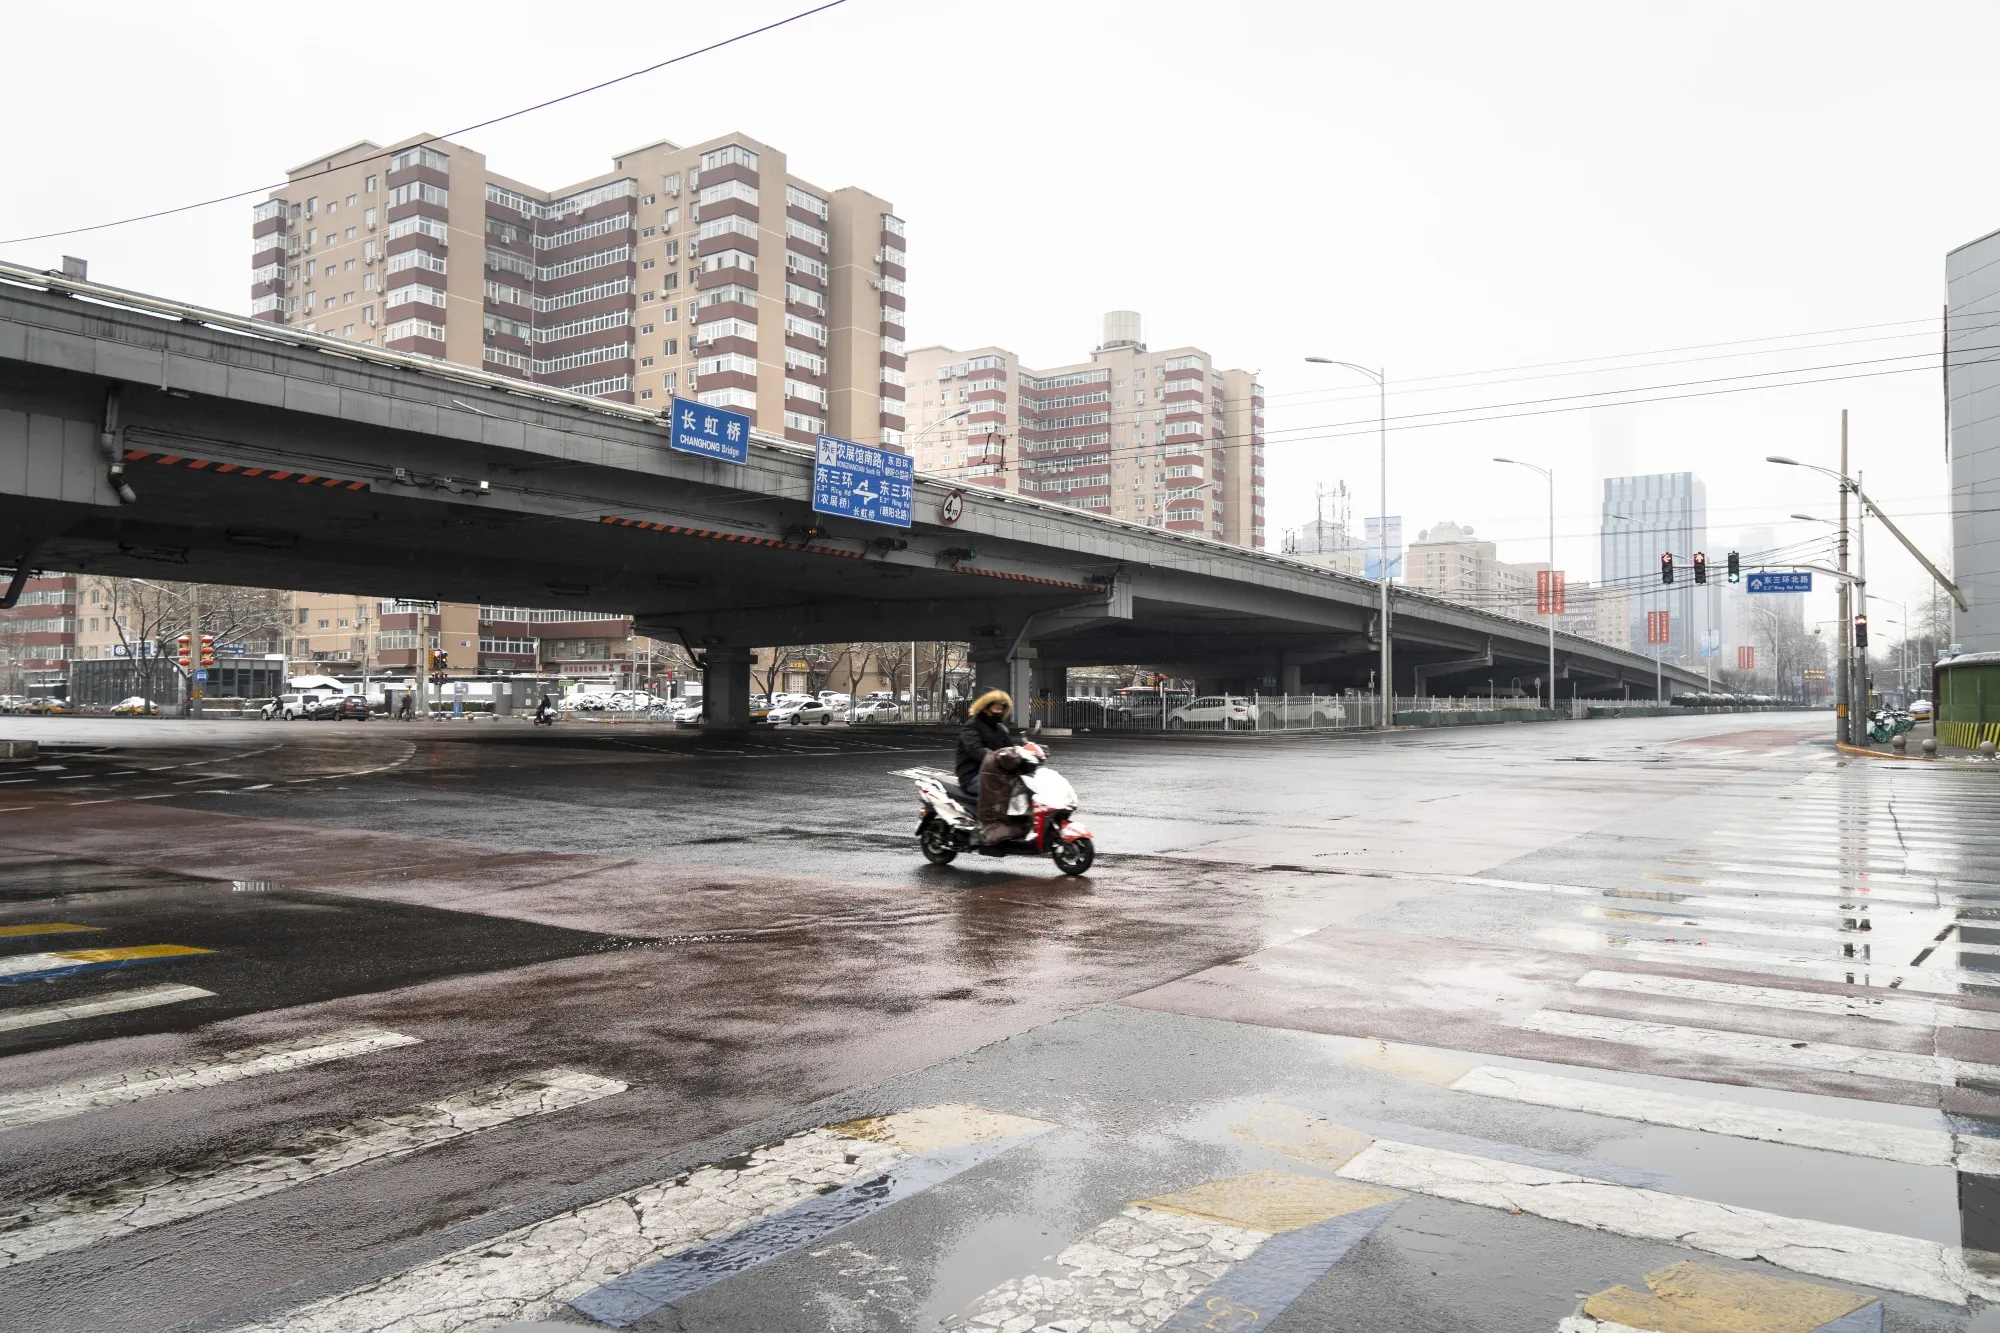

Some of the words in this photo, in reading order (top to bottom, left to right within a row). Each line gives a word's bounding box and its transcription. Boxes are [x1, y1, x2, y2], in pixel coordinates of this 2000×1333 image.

[681, 409, 741, 442] 长虹桥
[680, 434, 720, 452] CHANGHONG
[721, 444, 740, 458] Bridge
[821, 440, 831, 453] 东
[837, 442, 882, 469] 农展馆南路
[887, 455, 909, 469] 东四环
[817, 467, 853, 488] 东三环
[830, 486, 842, 497] Ring
[844, 489, 852, 497] Rd
[880, 480, 912, 501] 东三环
[891, 498, 902, 508] Ring
[903, 500, 910, 509] Rd
[853, 506, 876, 520] 长虹桥
[1764, 576, 1808, 584] 东三环北路
